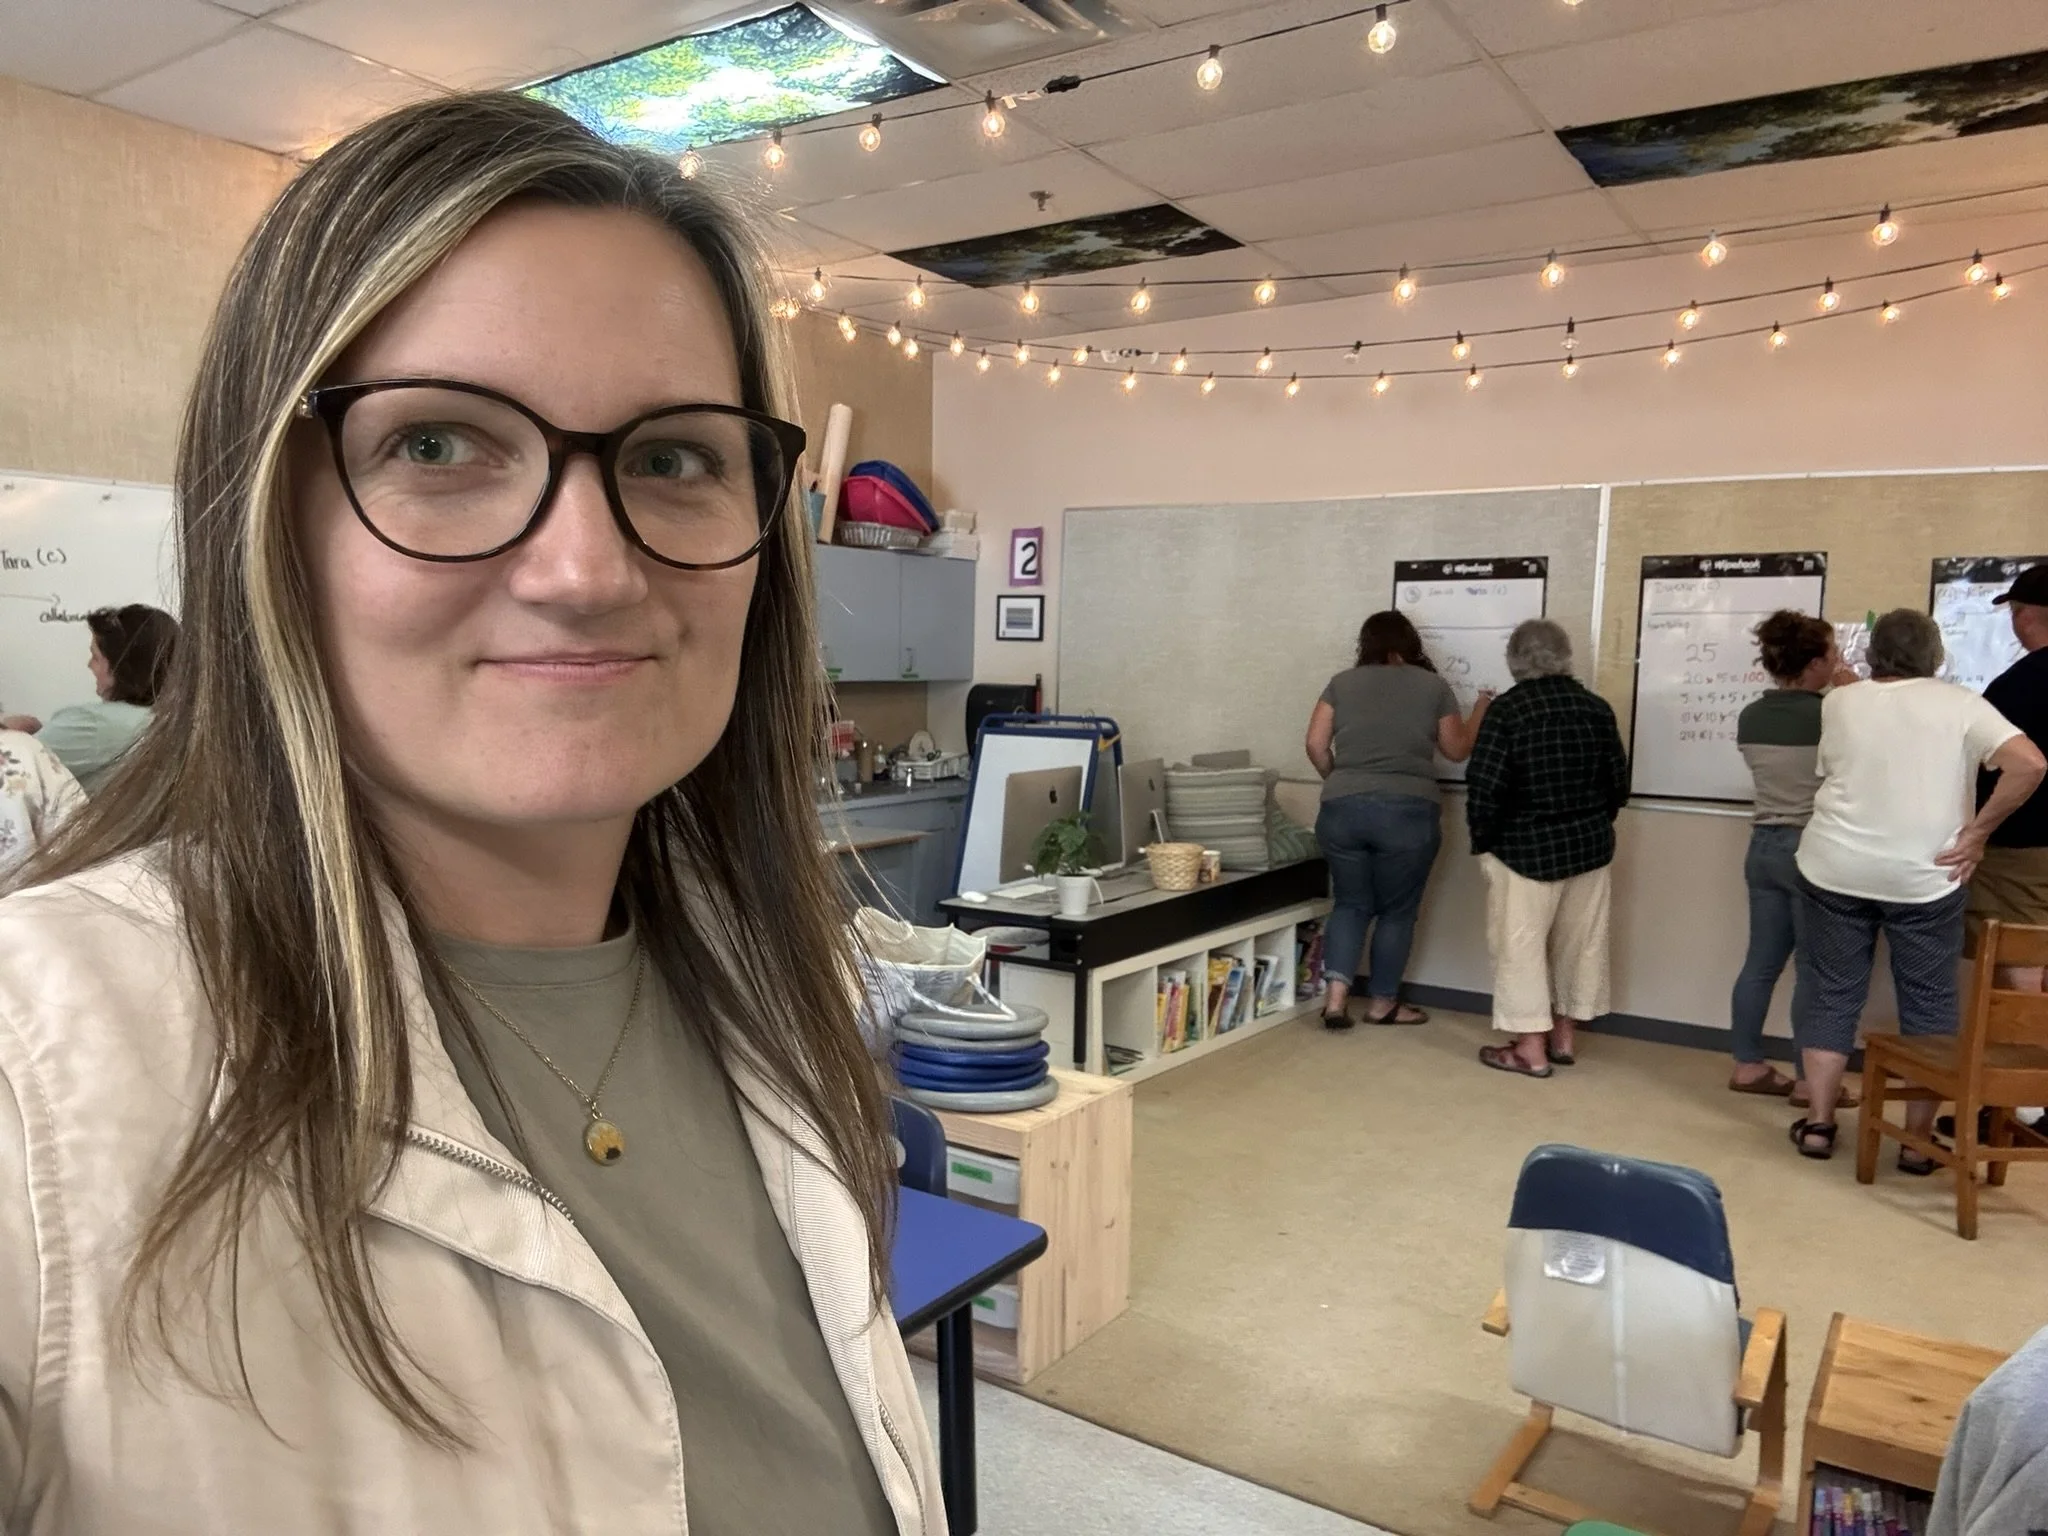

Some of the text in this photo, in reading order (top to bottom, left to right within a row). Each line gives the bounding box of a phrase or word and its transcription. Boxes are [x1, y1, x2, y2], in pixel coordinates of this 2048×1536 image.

[0, 549, 31, 570] Tara
[1020, 541, 1037, 576] 2
[1685, 642, 1719, 663] 25
[1742, 671, 1765, 684] 100
